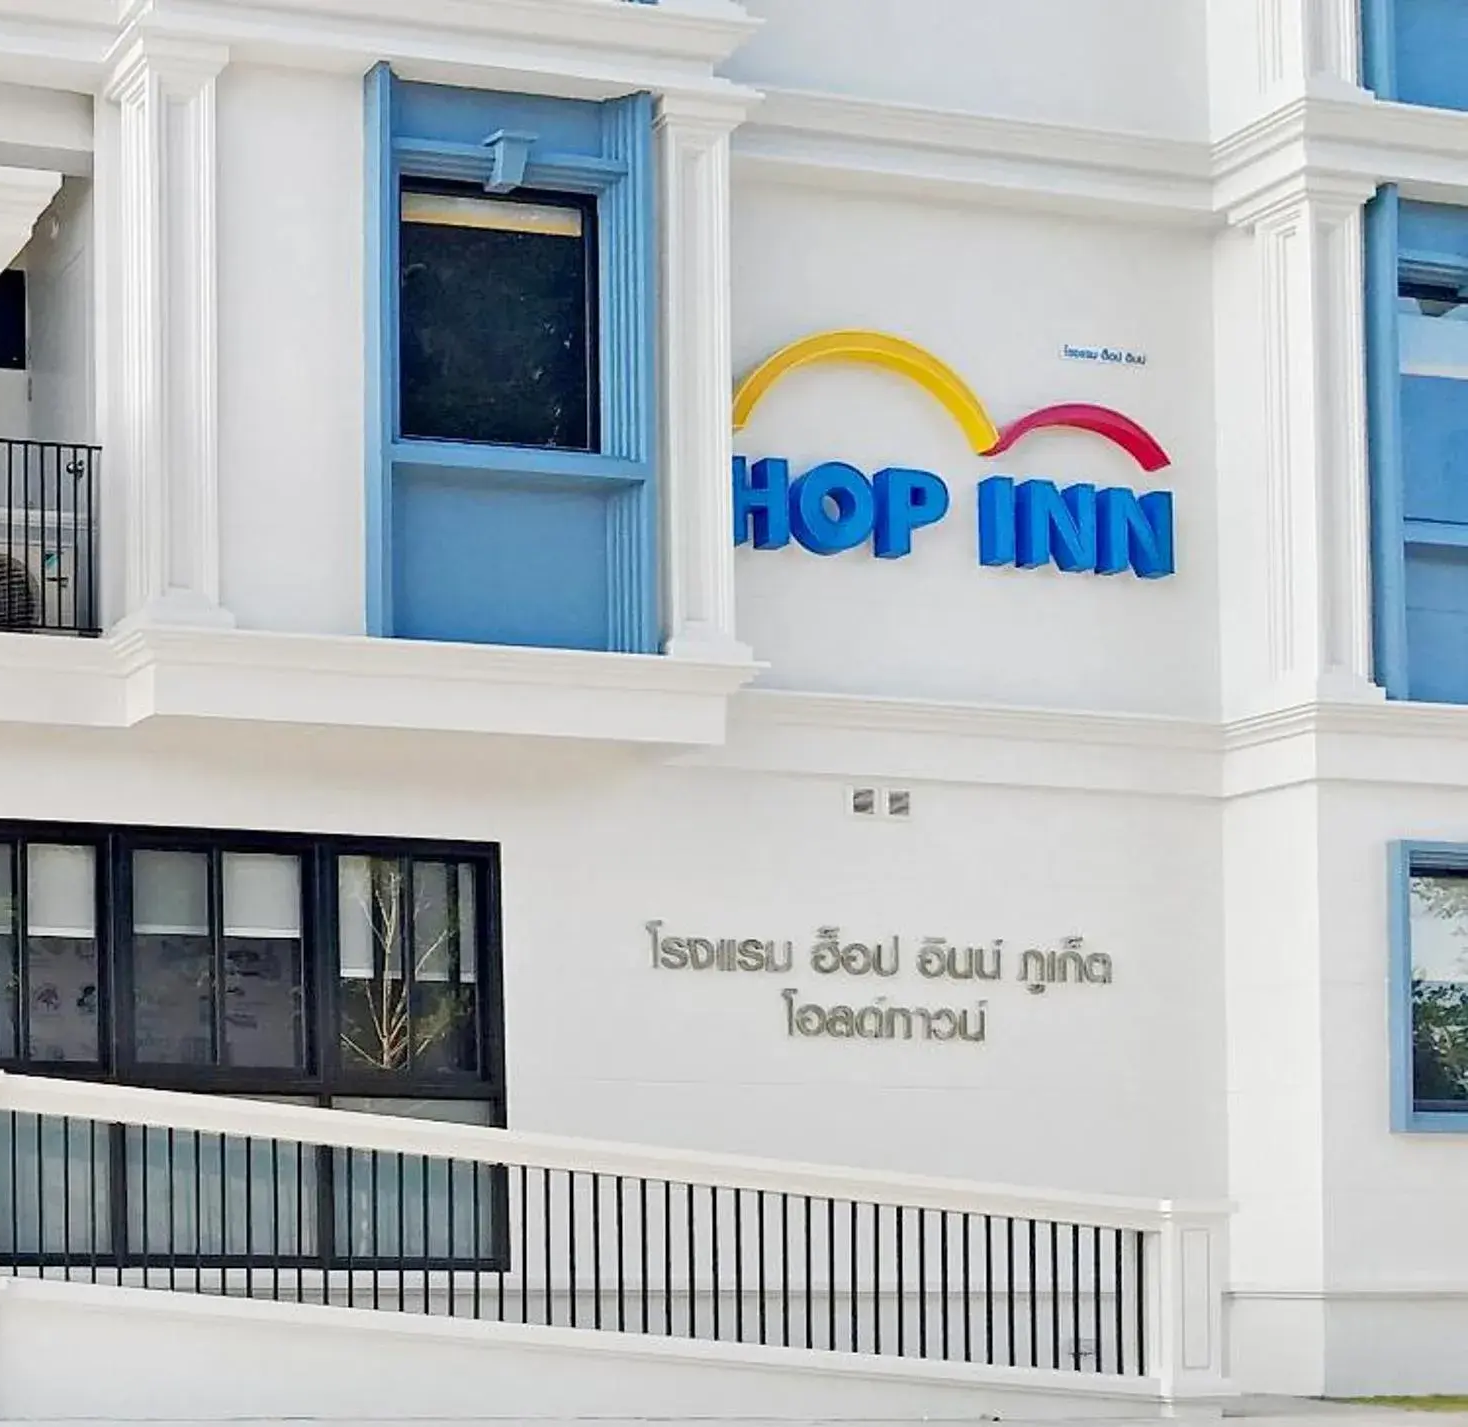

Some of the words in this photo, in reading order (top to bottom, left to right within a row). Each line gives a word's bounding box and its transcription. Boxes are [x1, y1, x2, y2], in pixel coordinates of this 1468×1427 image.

[732, 455, 949, 558] HOP
[978, 475, 1175, 579] INN
[645, 919, 793, 972] โรงแรม
[1016, 935, 1113, 995] ภูเก็ต
